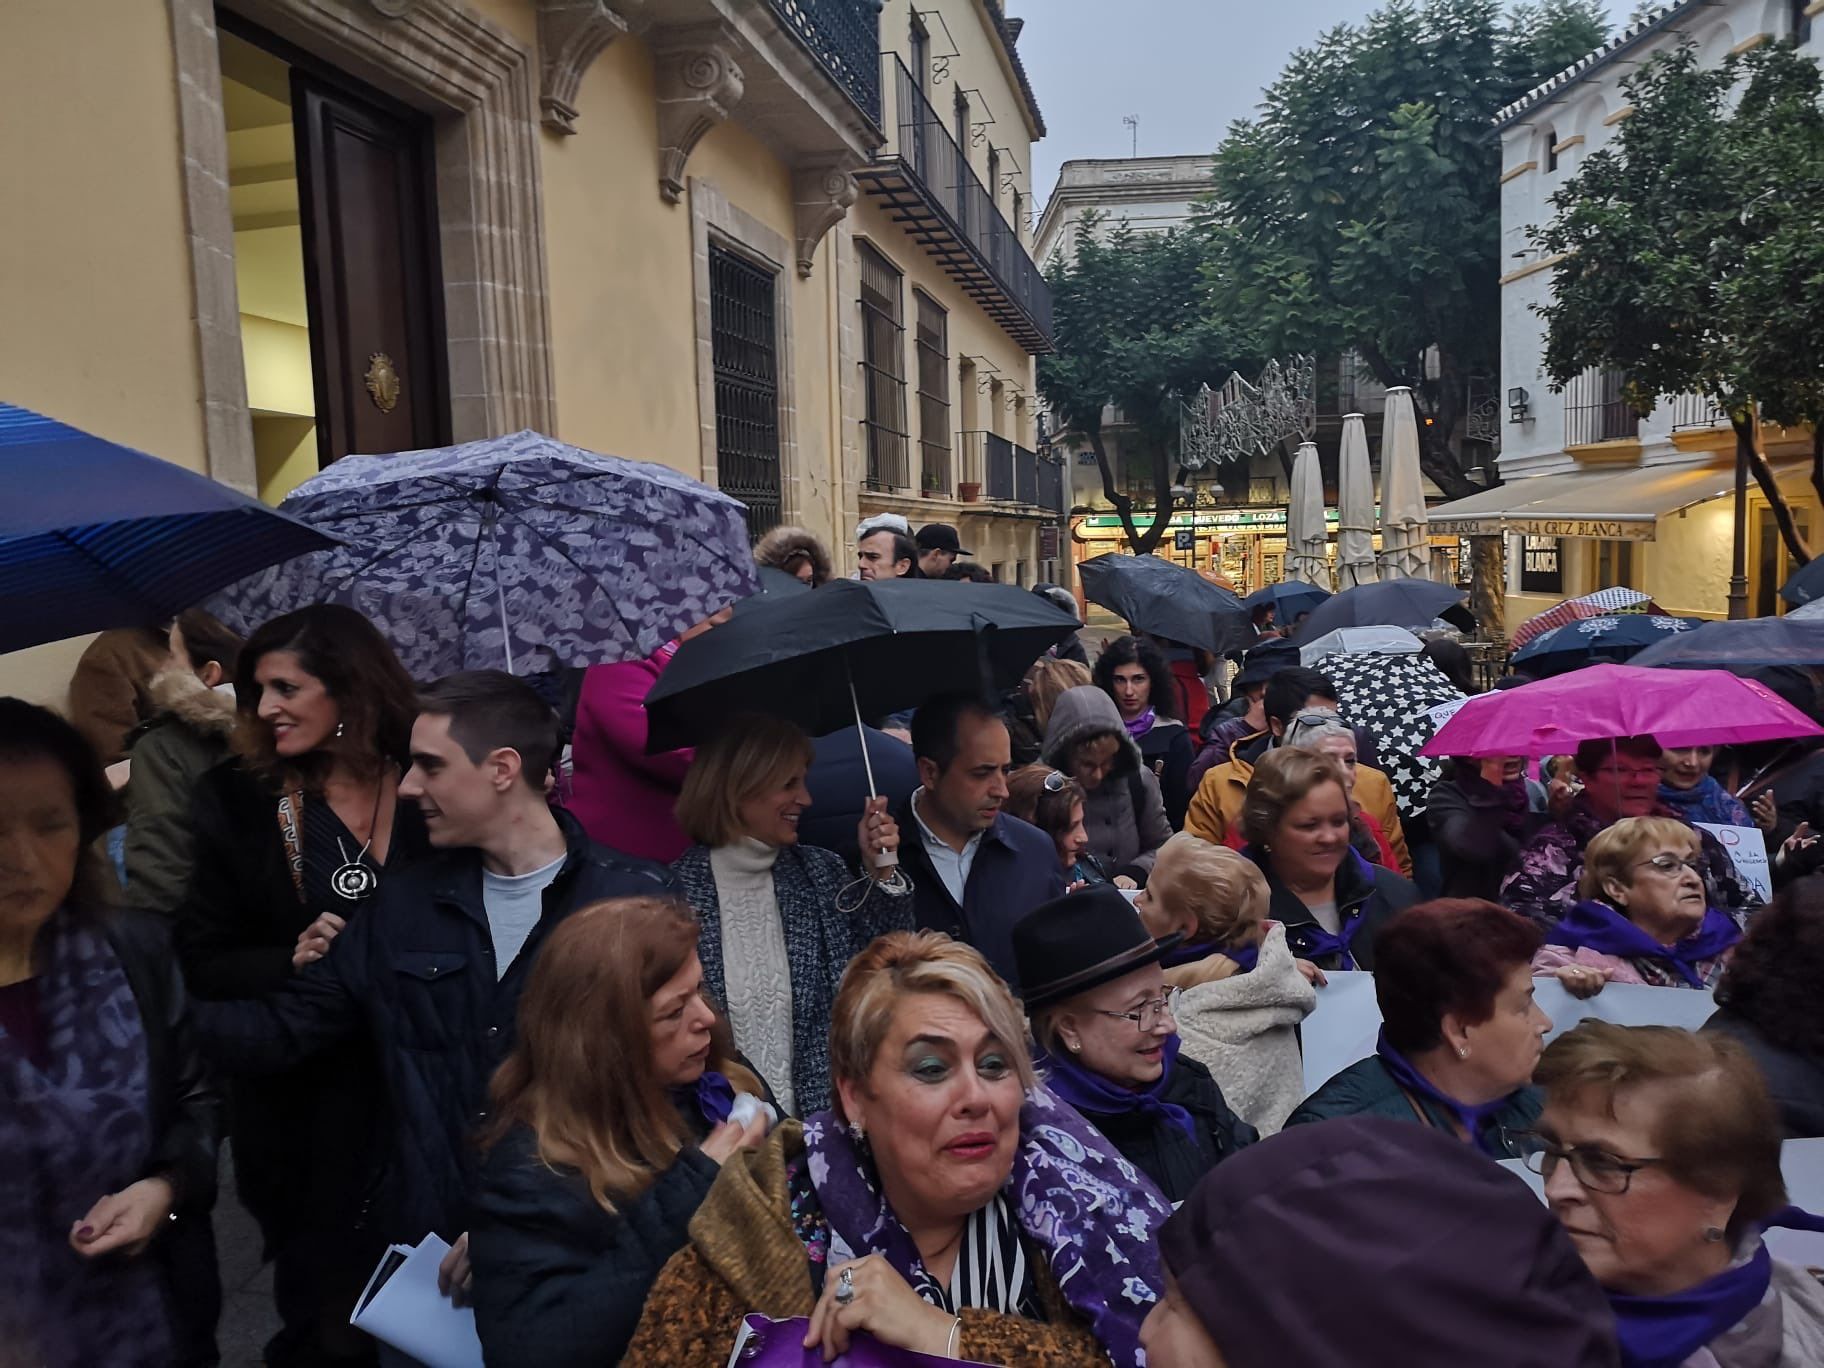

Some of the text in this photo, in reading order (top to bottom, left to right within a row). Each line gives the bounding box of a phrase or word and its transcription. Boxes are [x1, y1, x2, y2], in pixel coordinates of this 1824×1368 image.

[1252, 512, 1280, 521] LOZA
[1527, 521, 1623, 537] LA CRUZ BLANCA
[1525, 552, 1558, 572] BLANCA
